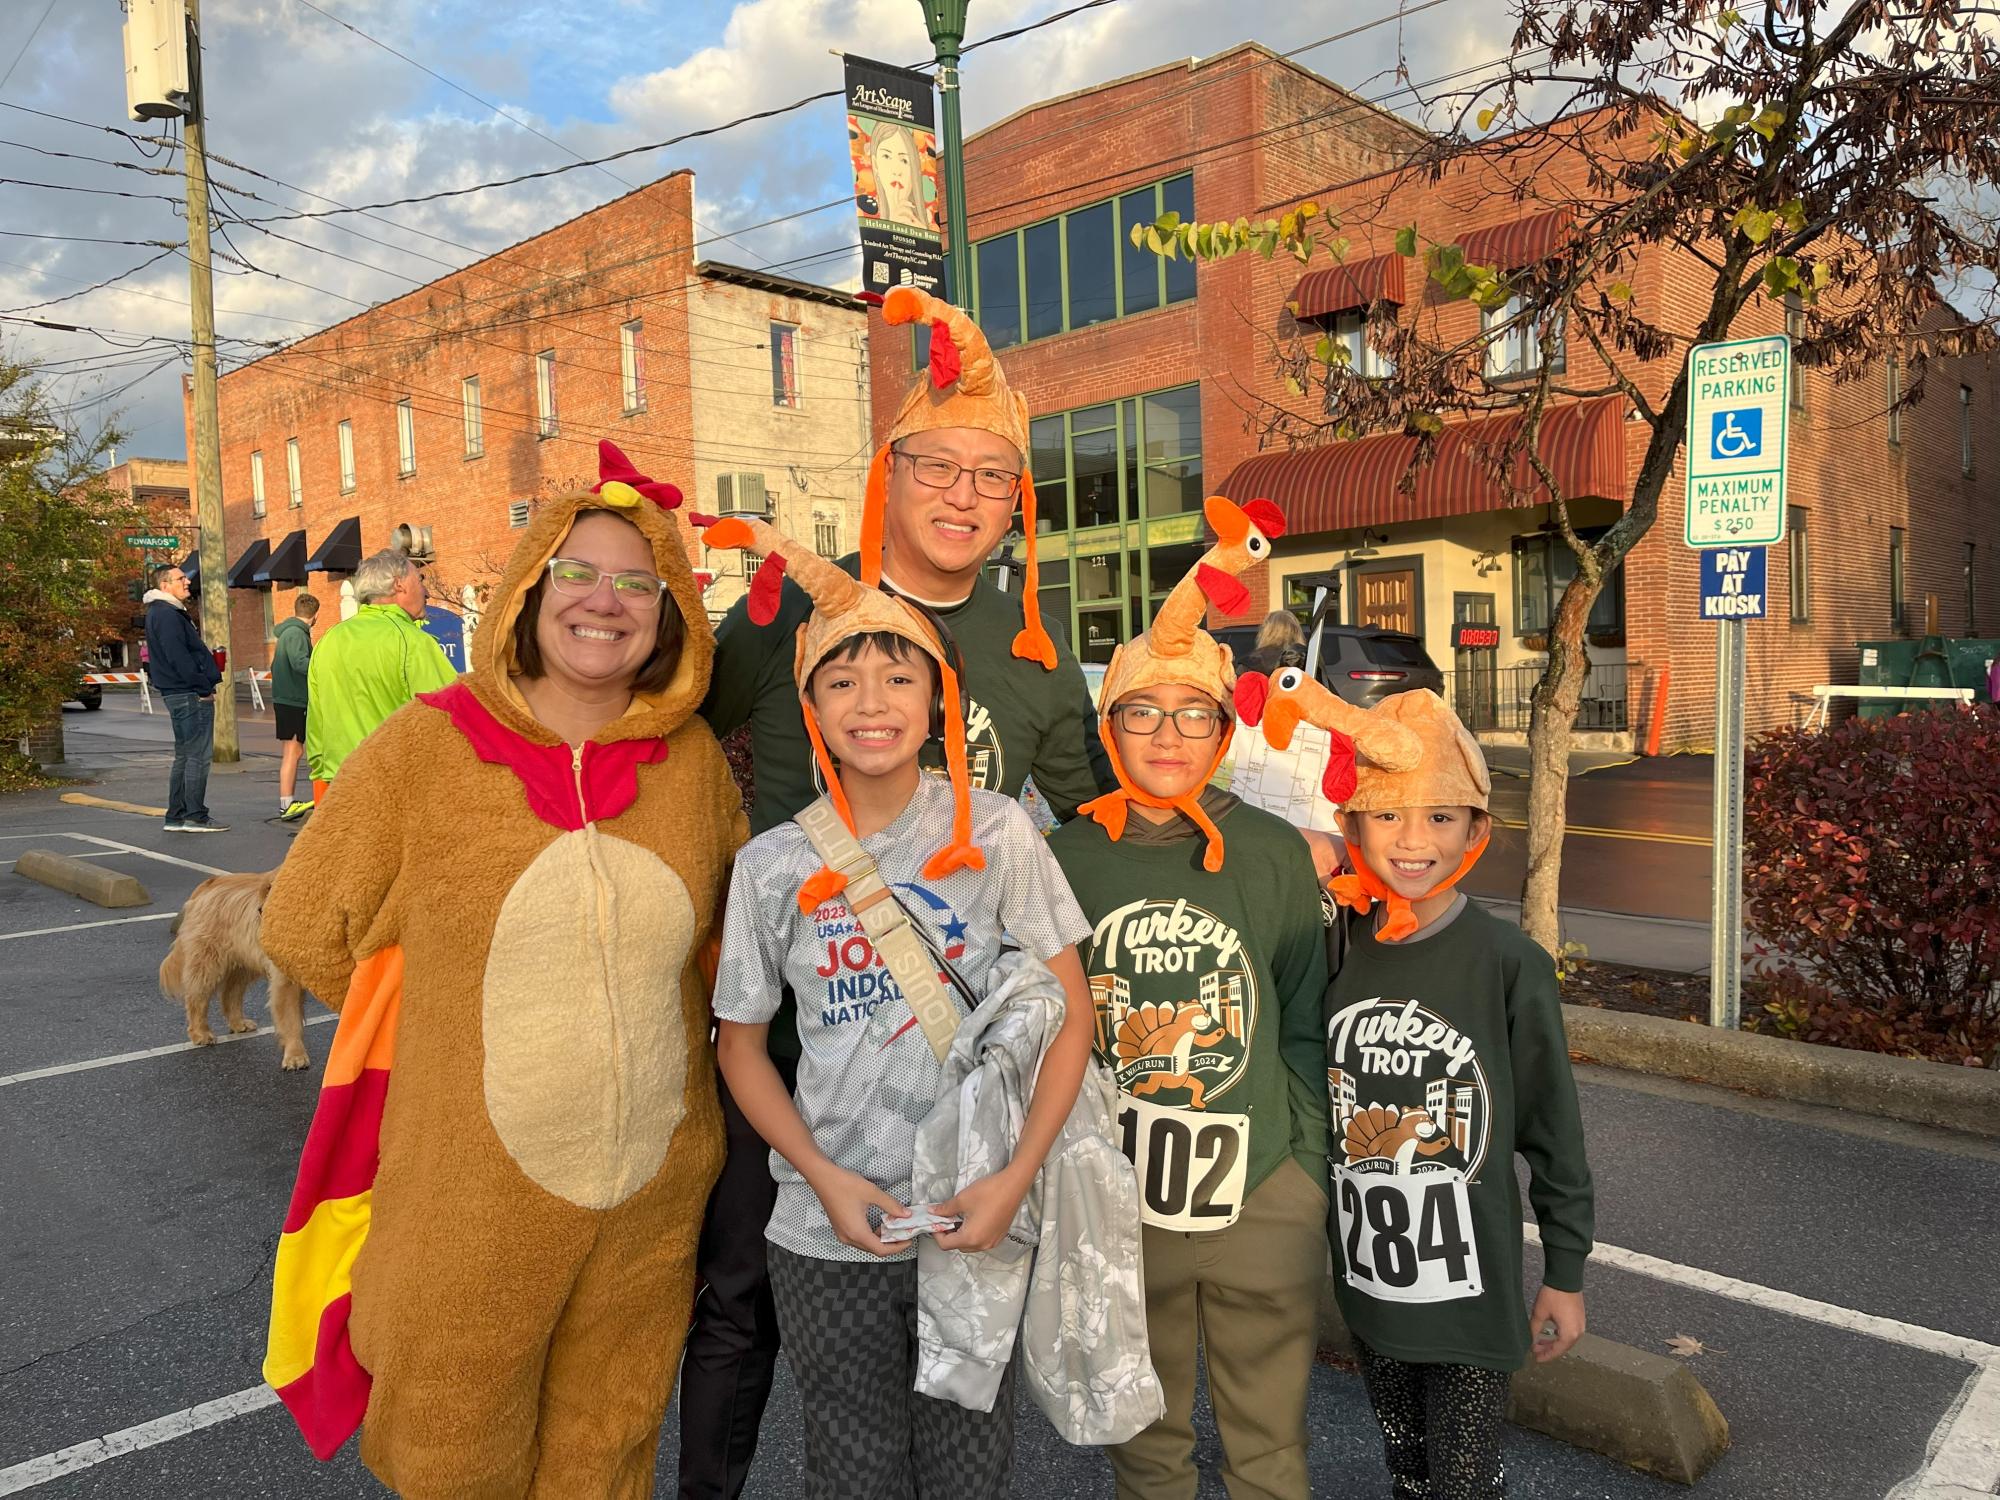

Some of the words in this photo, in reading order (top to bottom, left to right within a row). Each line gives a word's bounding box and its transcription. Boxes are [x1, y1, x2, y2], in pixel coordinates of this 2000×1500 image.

[866, 219, 890, 230] Helene
[889, 244, 905, 254] Therapy
[892, 234, 916, 244] SPONSOR
[913, 272, 938, 283] Dominion
[913, 279, 932, 289] Energy
[1697, 350, 1782, 377] RESERVED
[1701, 375, 1776, 400] PARKING
[1698, 478, 1773, 497] MAXIMUM
[1700, 496, 1770, 514] PENALTY
[1091, 556, 1107, 567] 121
[1715, 551, 1751, 573] PAY
[1721, 573, 1746, 595] AT
[1705, 594, 1761, 617] KIOSK
[814, 905, 847, 923] 2023
[1093, 898, 1242, 969] Turkey
[1130, 945, 1201, 974] TROT
[1328, 996, 1476, 1077] Turkey
[1194, 1056, 1216, 1067] 2024
[1359, 1046, 1430, 1077] TROT
[1118, 1106, 1240, 1218] 102
[1342, 1178, 1471, 1288] 284
